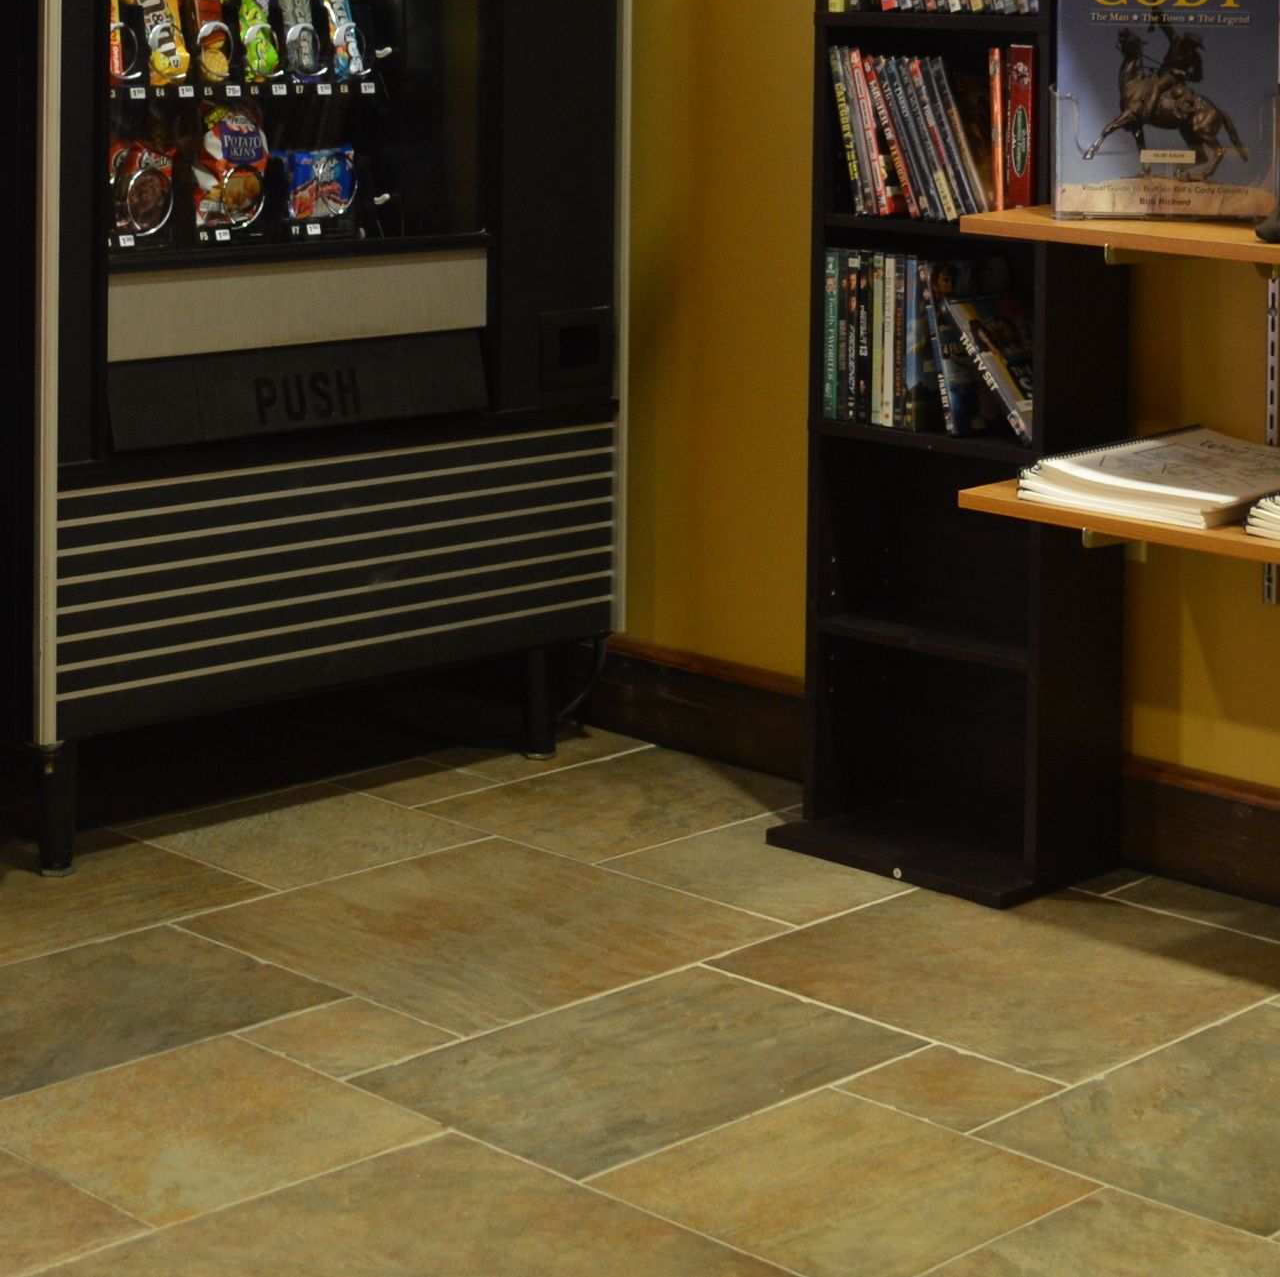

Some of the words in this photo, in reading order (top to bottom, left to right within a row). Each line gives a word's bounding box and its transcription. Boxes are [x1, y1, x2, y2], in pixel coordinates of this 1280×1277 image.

[1090, 12, 1109, 22] The
[1111, 13, 1130, 22] Man
[1142, 13, 1163, 22] The
[1167, 13, 1186, 24] Town
[1198, 14, 1216, 24] The
[1217, 15, 1251, 27] Legend
[833, 82, 852, 139] CATEGORY
[223, 135, 262, 152] POTATO
[229, 147, 258, 161] SKINS
[1081, 183, 1106, 192] Visual
[1194, 186, 1216, 197] Cody
[1217, 187, 1250, 198] Country
[1139, 196, 1157, 206] Bob
[1158, 197, 1192, 207] Richard
[199, 231, 209, 242] F5
[291, 226, 301, 236] F7
[826, 327, 838, 381] FAVORITES
[859, 344, 868, 357] 13
[848, 324, 856, 394] FREQUENCY
[959, 332, 976, 357] THE
[973, 356, 988, 374] TV
[982, 372, 999, 392] SET
[255, 368, 361, 424] PUSH
[1199, 438, 1247, 457] Wild
